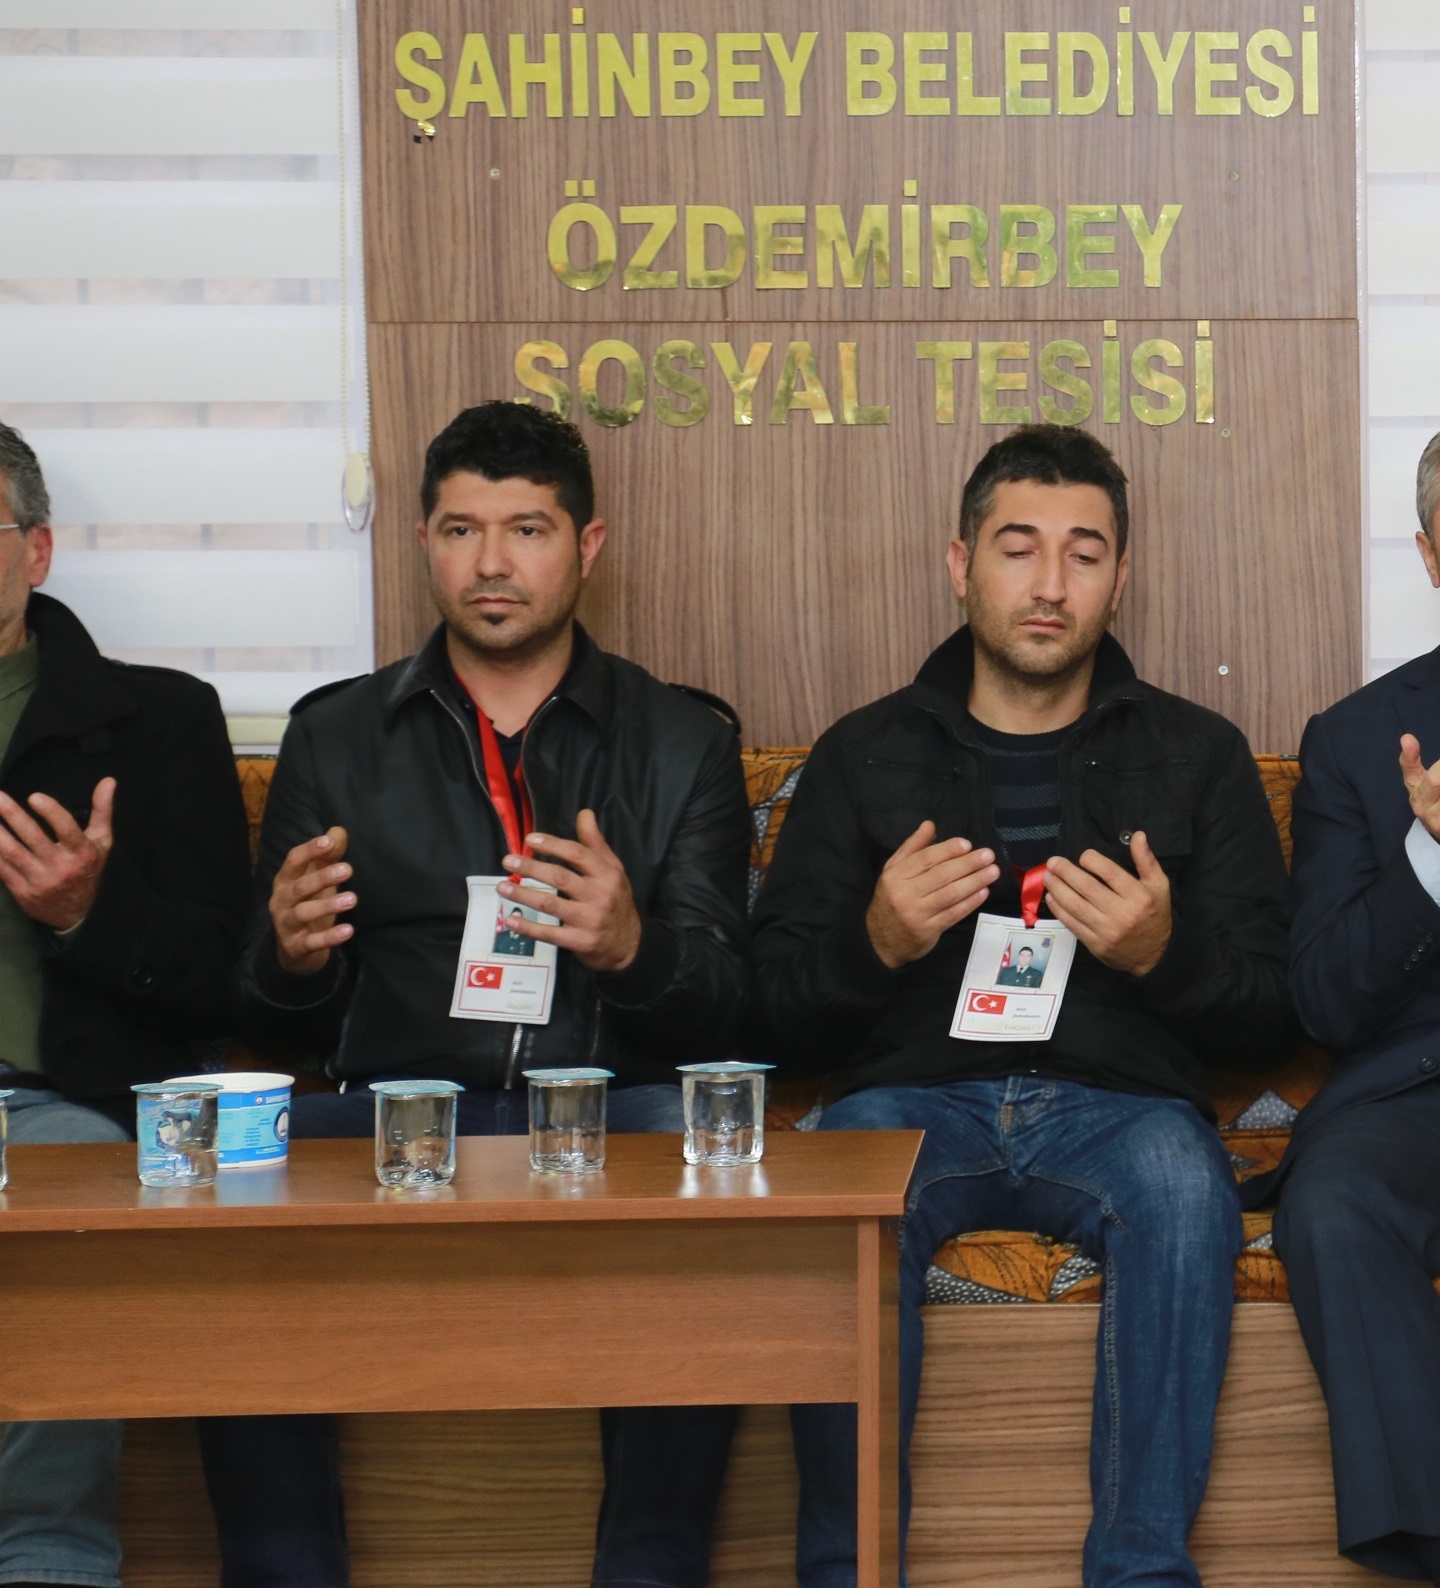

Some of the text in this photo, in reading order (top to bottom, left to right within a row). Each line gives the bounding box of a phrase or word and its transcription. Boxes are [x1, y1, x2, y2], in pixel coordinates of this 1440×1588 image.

[394, 6, 1321, 143] ŞAHİNBEY BELEDİYESİ
[547, 179, 1184, 291] ÖZDEMİRBEY
[513, 319, 1215, 427] SOSYAL TESİSİ
